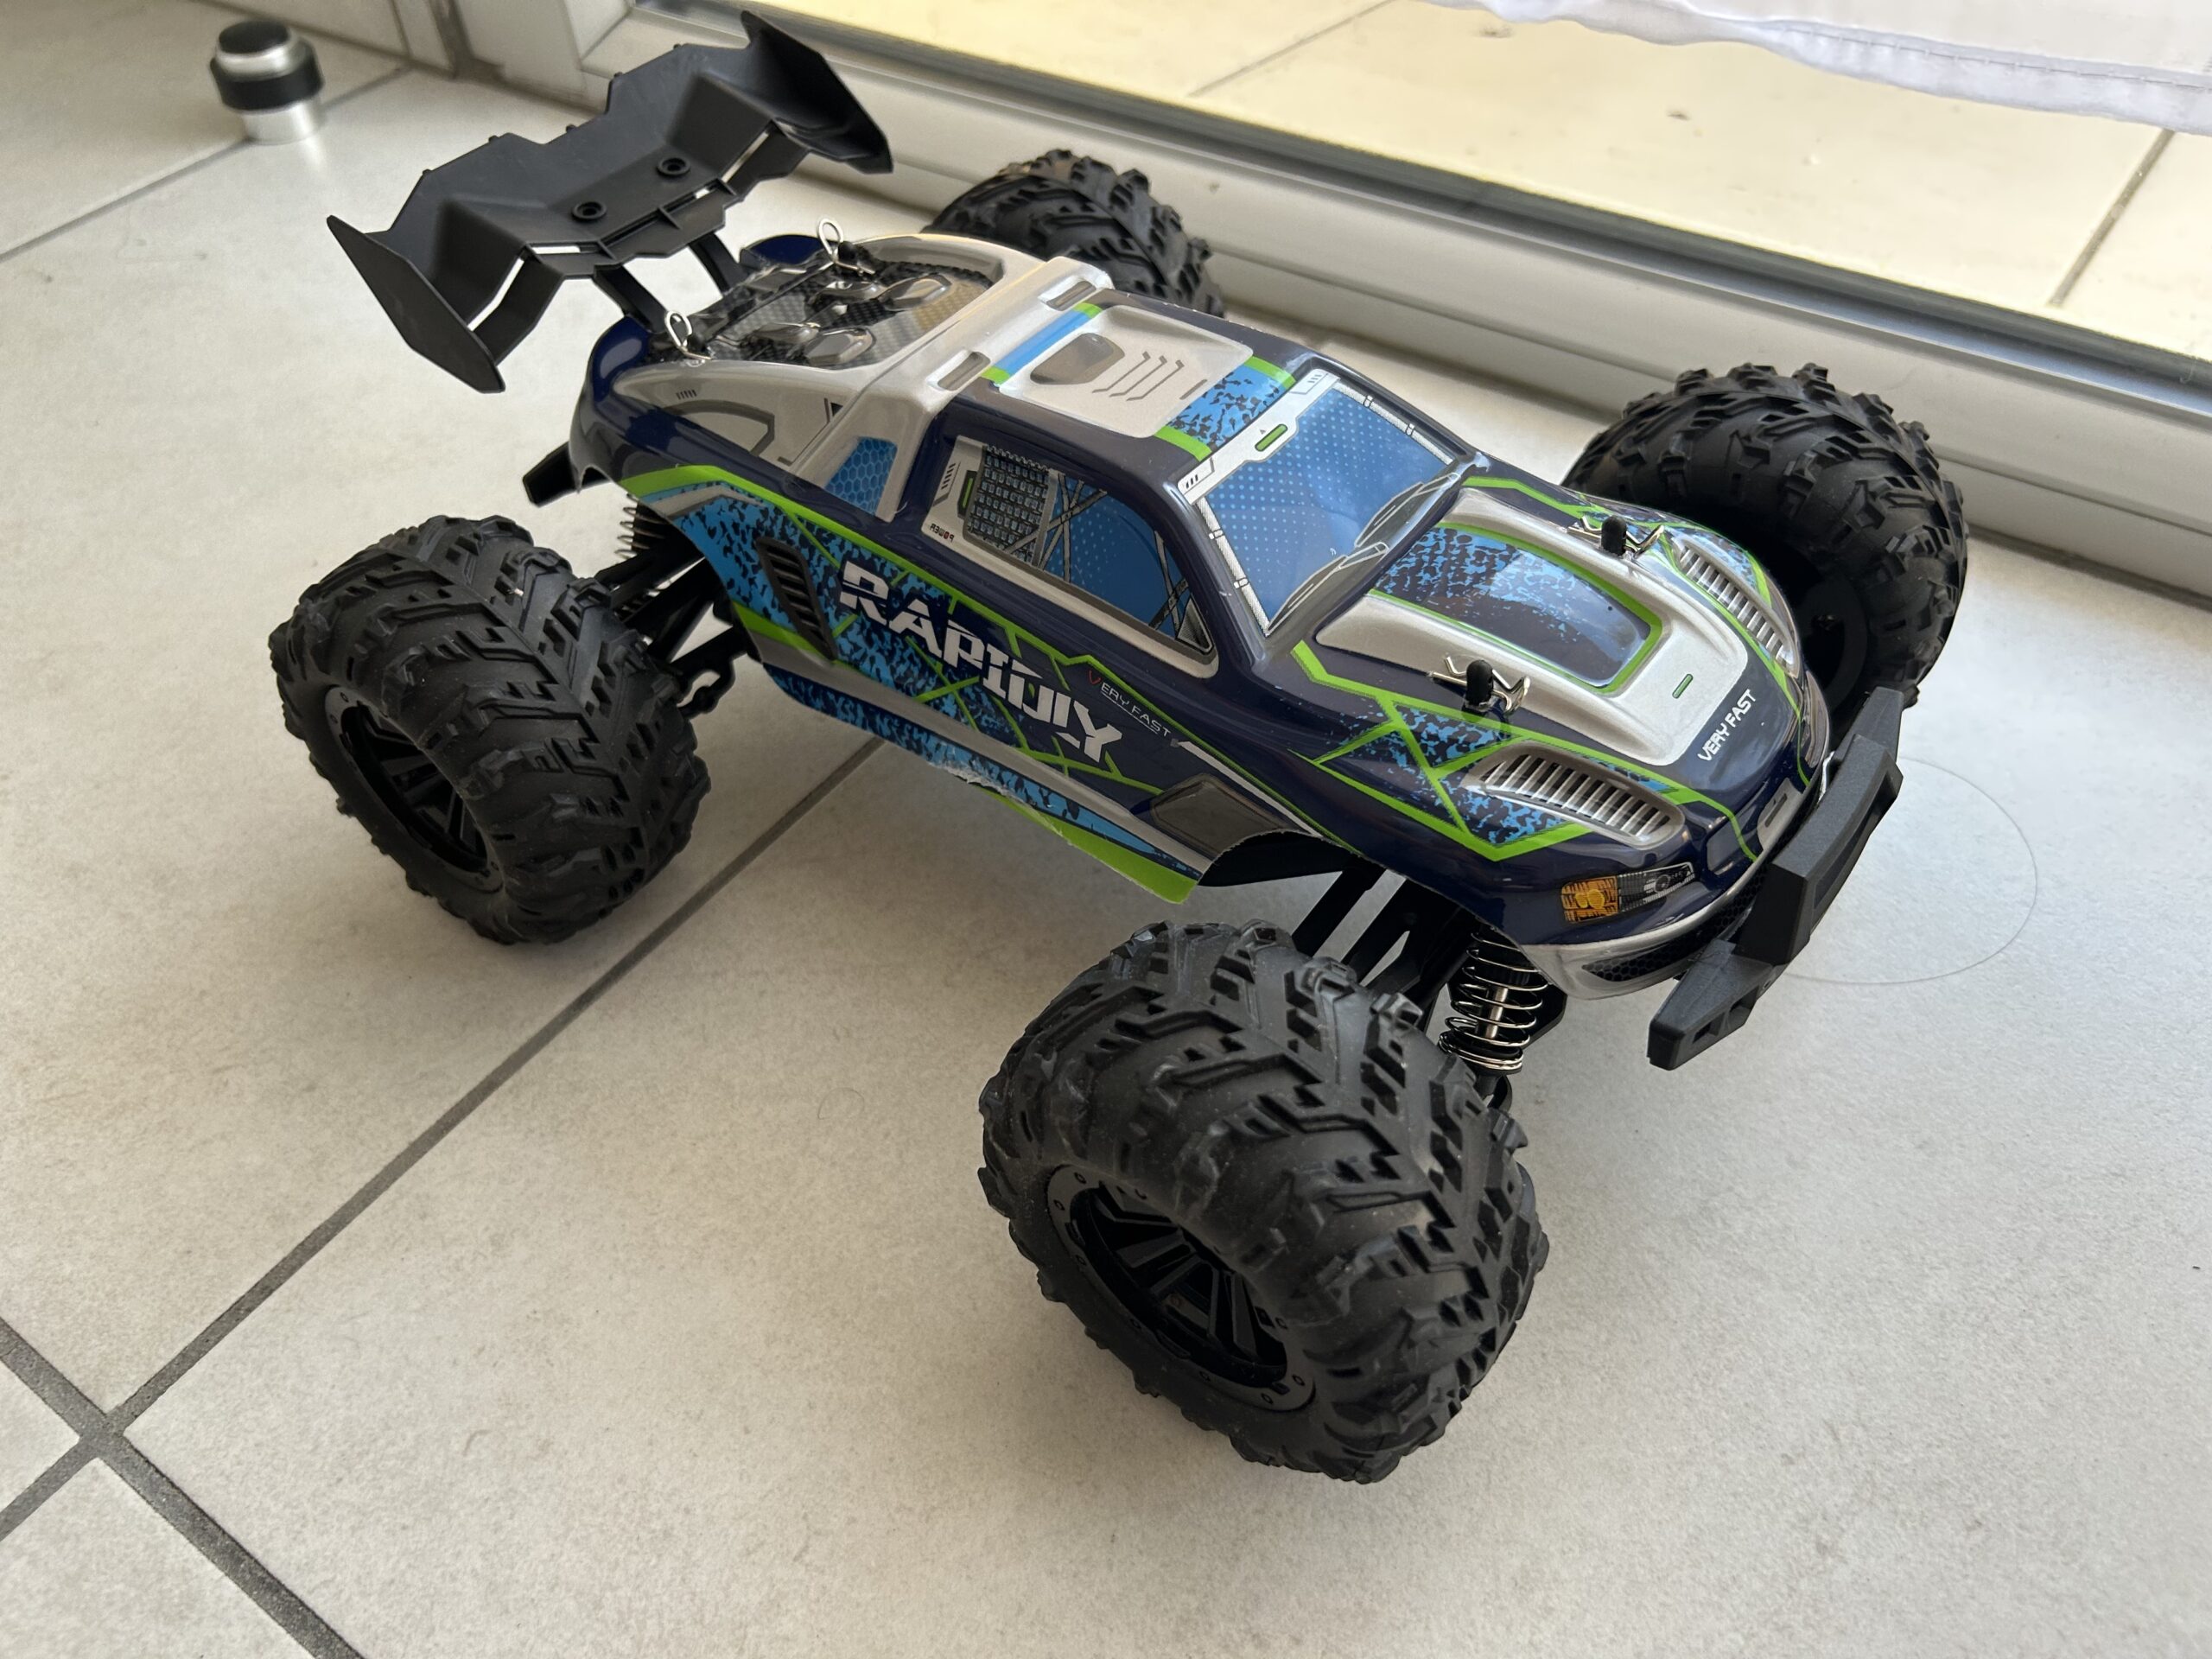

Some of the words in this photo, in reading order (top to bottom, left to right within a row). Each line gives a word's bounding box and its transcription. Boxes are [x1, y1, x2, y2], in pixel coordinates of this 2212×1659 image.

[1089, 670, 1130, 706] VERY
[1131, 705, 1172, 737] FAST
[1697, 722, 1730, 761] VERY
[1725, 689, 1757, 728] FAST
